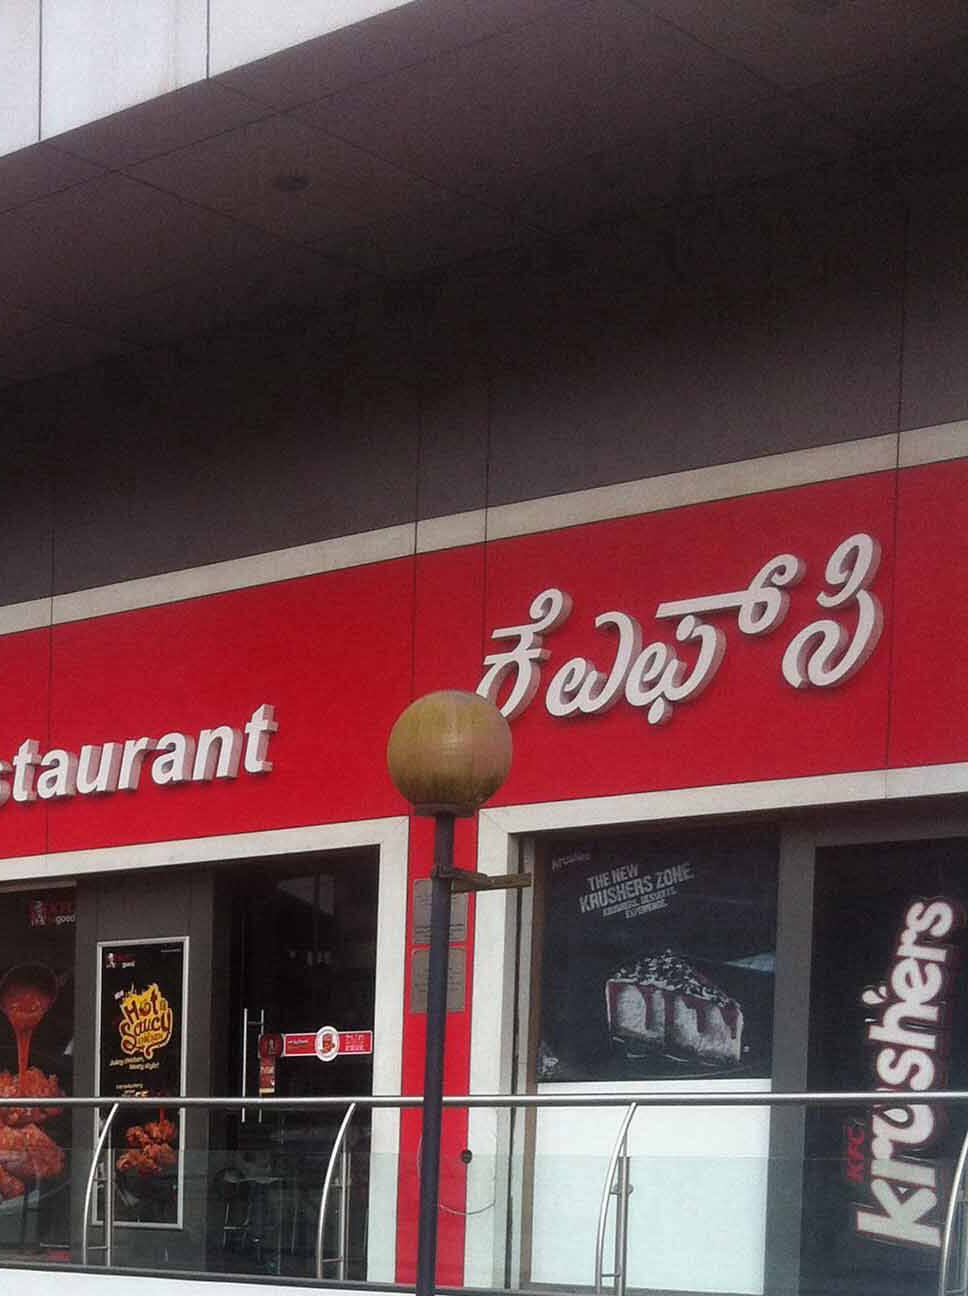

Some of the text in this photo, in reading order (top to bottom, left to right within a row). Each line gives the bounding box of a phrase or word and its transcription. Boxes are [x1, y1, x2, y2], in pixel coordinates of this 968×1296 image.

[579, 875, 653, 912] KRUSHERS
[587, 864, 639, 891] THE NEW
[124, 991, 158, 1024] Hot
[856, 899, 954, 1248] krushers
